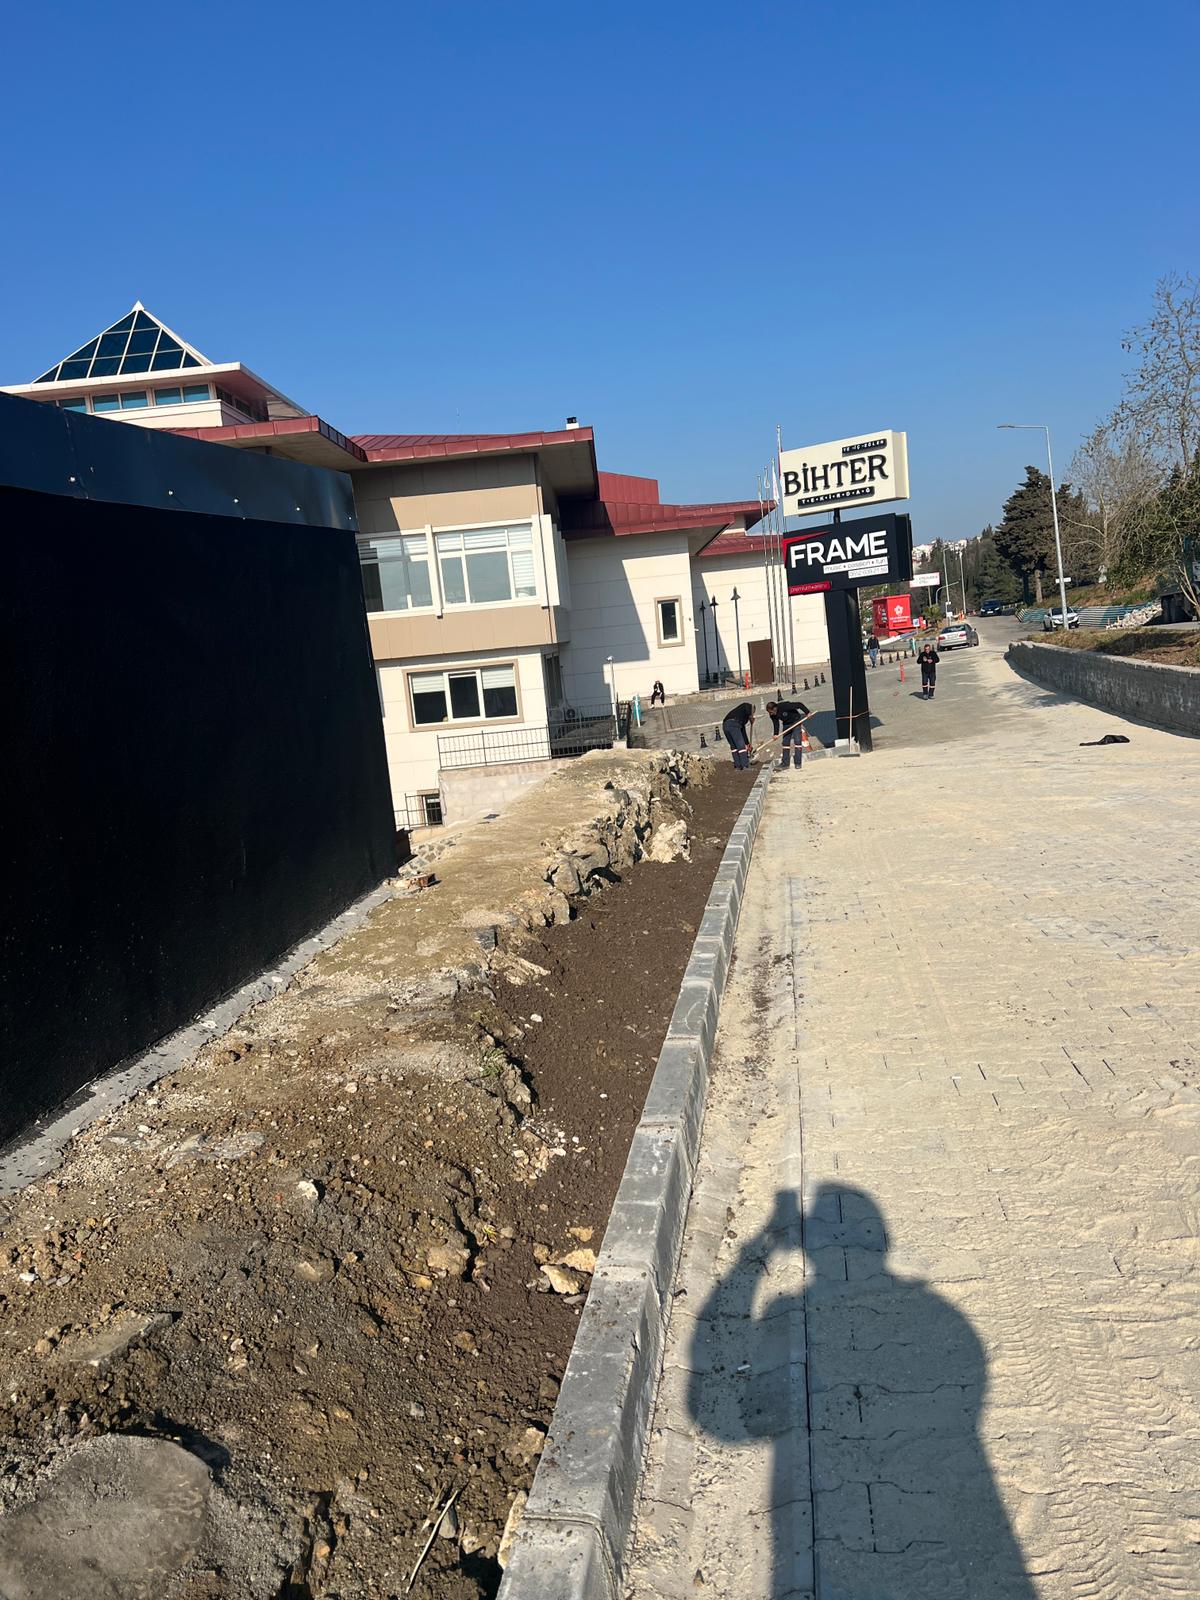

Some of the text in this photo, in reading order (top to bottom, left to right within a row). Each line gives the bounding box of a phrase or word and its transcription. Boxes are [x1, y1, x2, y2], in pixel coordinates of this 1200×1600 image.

[783, 454, 889, 497] BİHTER
[789, 530, 888, 569] FRAME
[825, 564, 843, 572] music
[847, 560, 870, 569] passion
